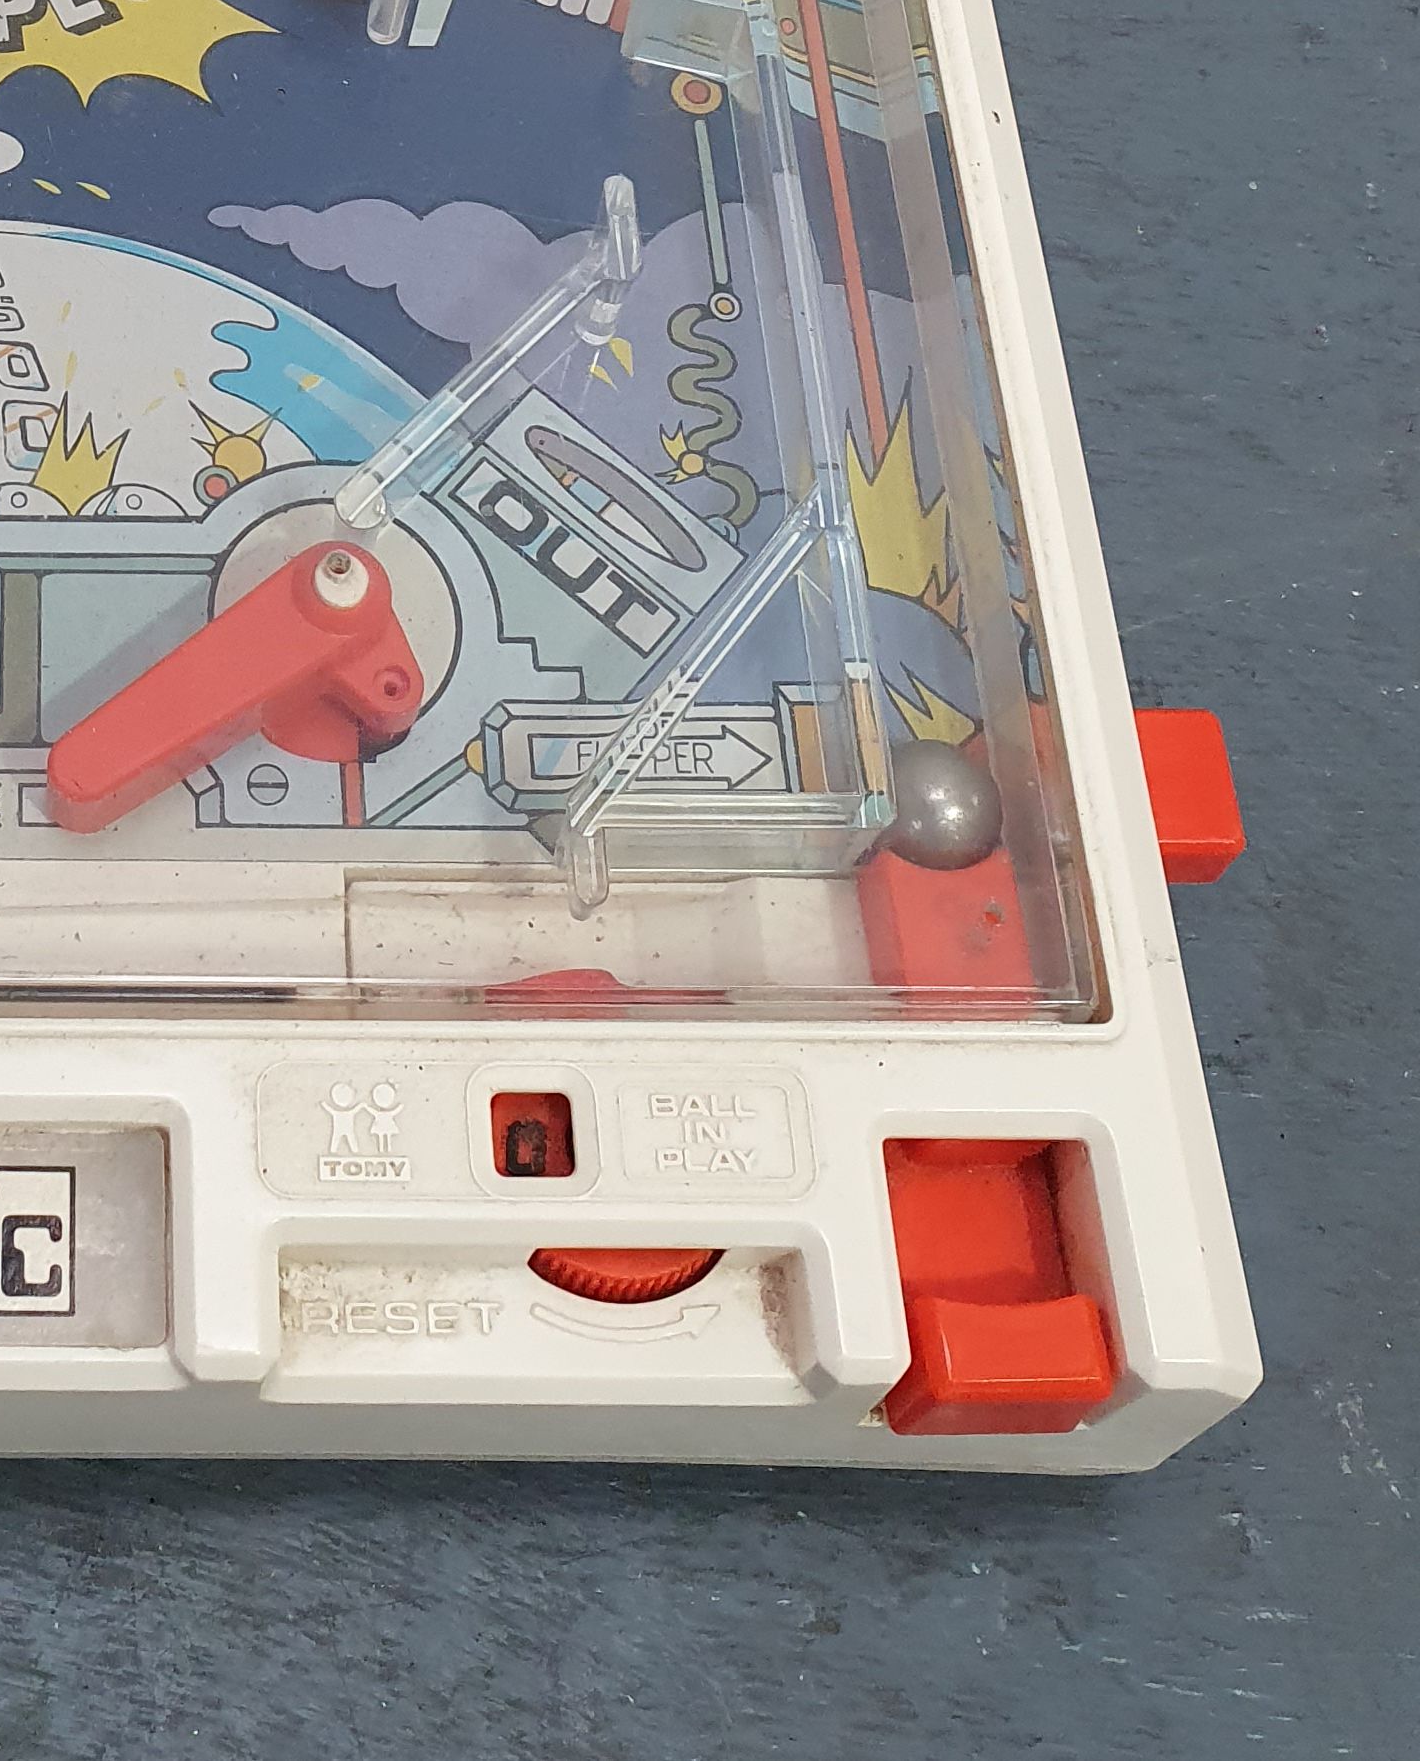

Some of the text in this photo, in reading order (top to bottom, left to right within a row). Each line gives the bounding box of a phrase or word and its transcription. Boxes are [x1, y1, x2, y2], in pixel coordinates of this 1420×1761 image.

[479, 480, 660, 629] OUT
[648, 1094, 757, 1119] BALL
[682, 1119, 728, 1145] IN
[322, 1160, 408, 1179] TOMY
[656, 1147, 759, 1174] PLAY
[300, 1300, 502, 1337] RESET
